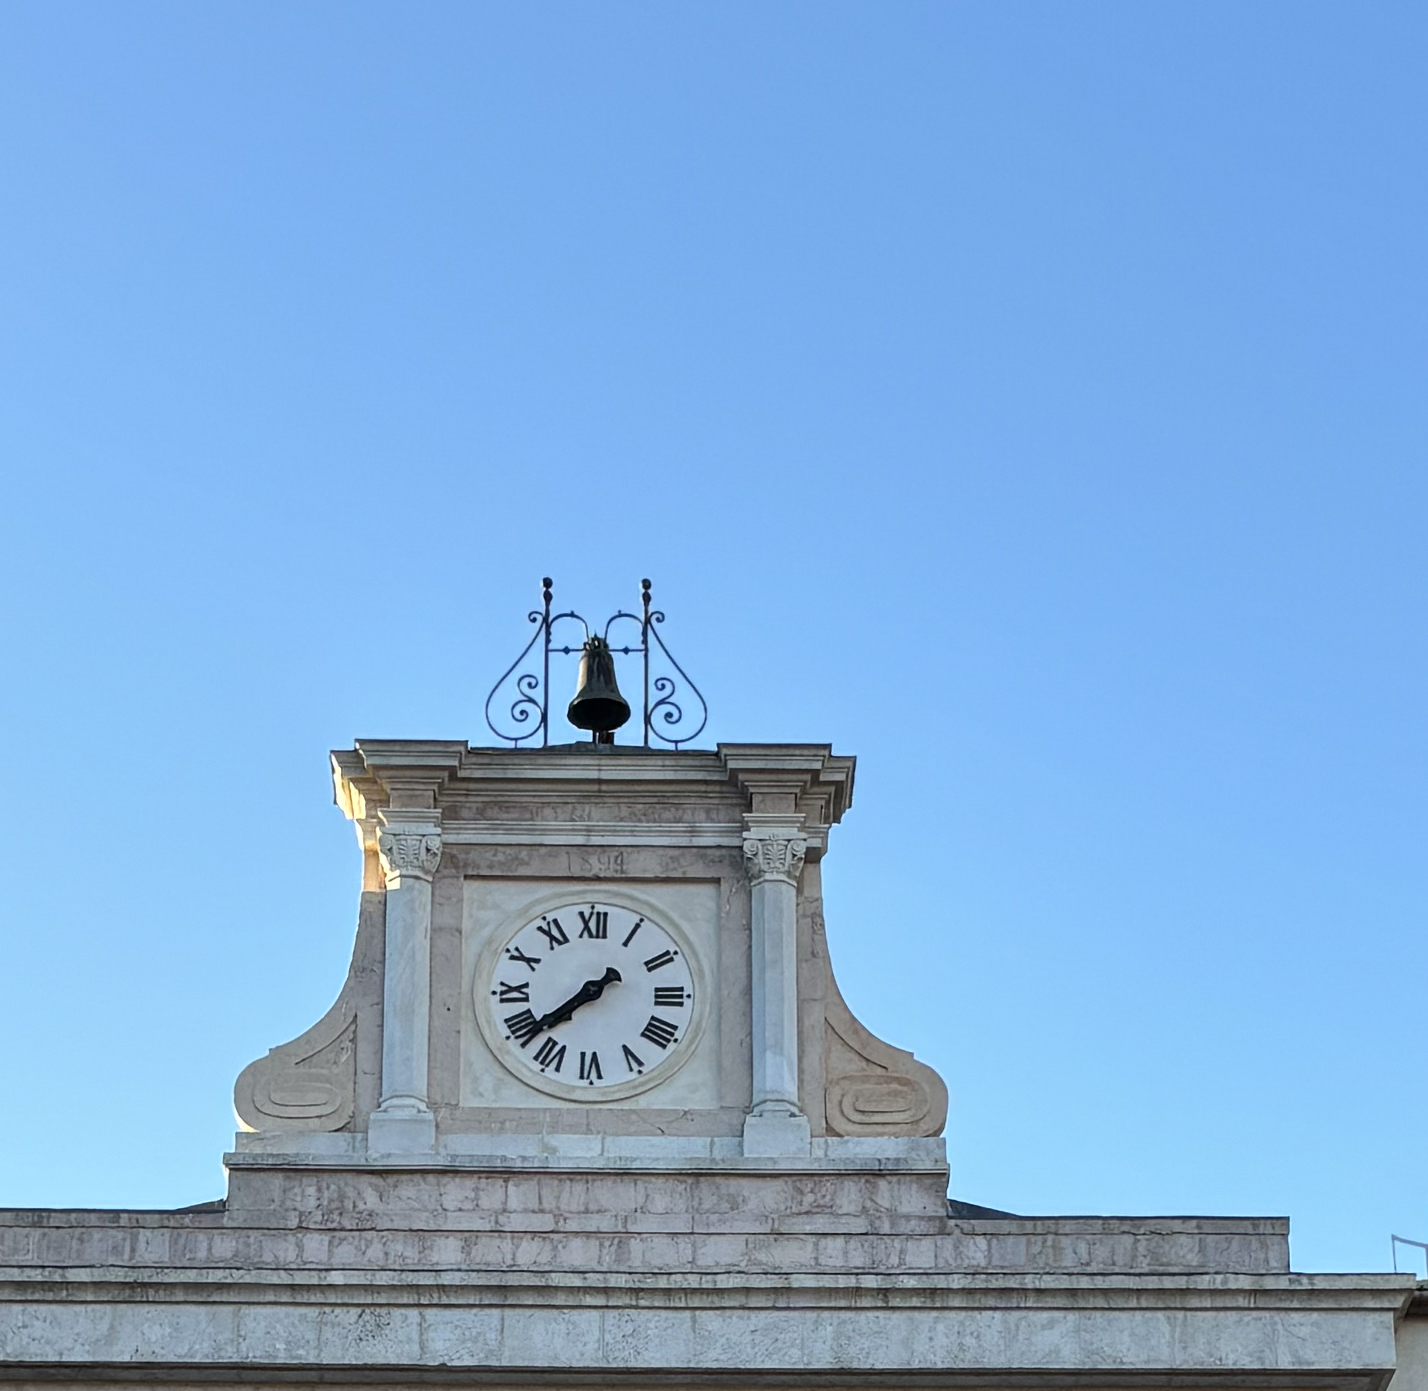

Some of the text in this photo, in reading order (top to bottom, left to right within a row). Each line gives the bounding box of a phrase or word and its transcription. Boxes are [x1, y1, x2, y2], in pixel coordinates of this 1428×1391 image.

[536, 918, 570, 950] XI
[578, 911, 609, 939] XII
[508, 946, 542, 972] X
[643, 950, 675, 973] II
[499, 981, 530, 1003] IX
[654, 986, 684, 1008] III
[533, 1036, 567, 1073] VII
[579, 1051, 604, 1080] VI
[621, 1044, 645, 1072] V
